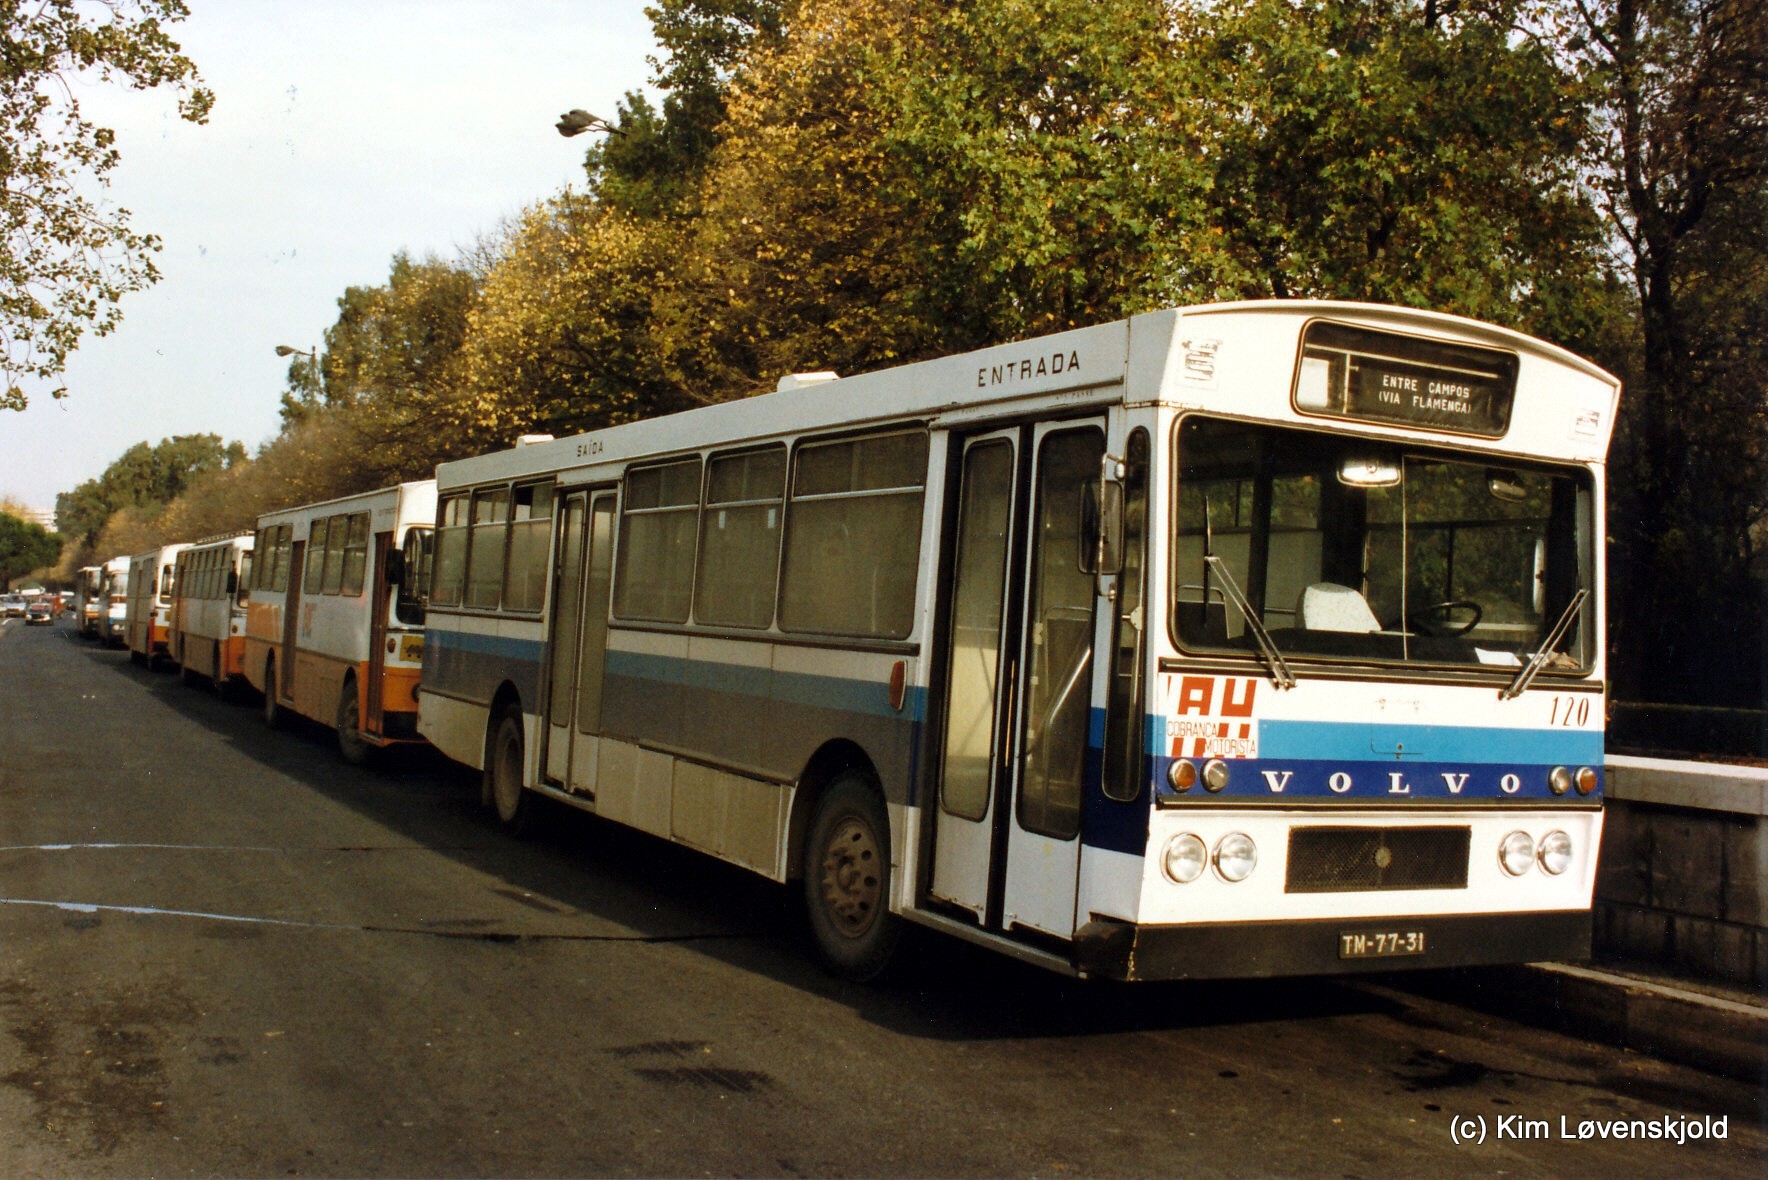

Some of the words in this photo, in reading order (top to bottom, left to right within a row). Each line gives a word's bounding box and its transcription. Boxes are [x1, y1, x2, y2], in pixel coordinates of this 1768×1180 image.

[978, 350, 1080, 387] ENTRADA
[1378, 391, 1400, 404] (VIA
[1382, 374, 1418, 391] ENTRE
[1428, 382, 1470, 399] CAMPOS
[1551, 696, 1589, 727] 120
[1205, 739, 1257, 754] MOTORISTA
[1261, 770, 1521, 793] VOLVO
[1342, 932, 1424, 955] TM-77-31
